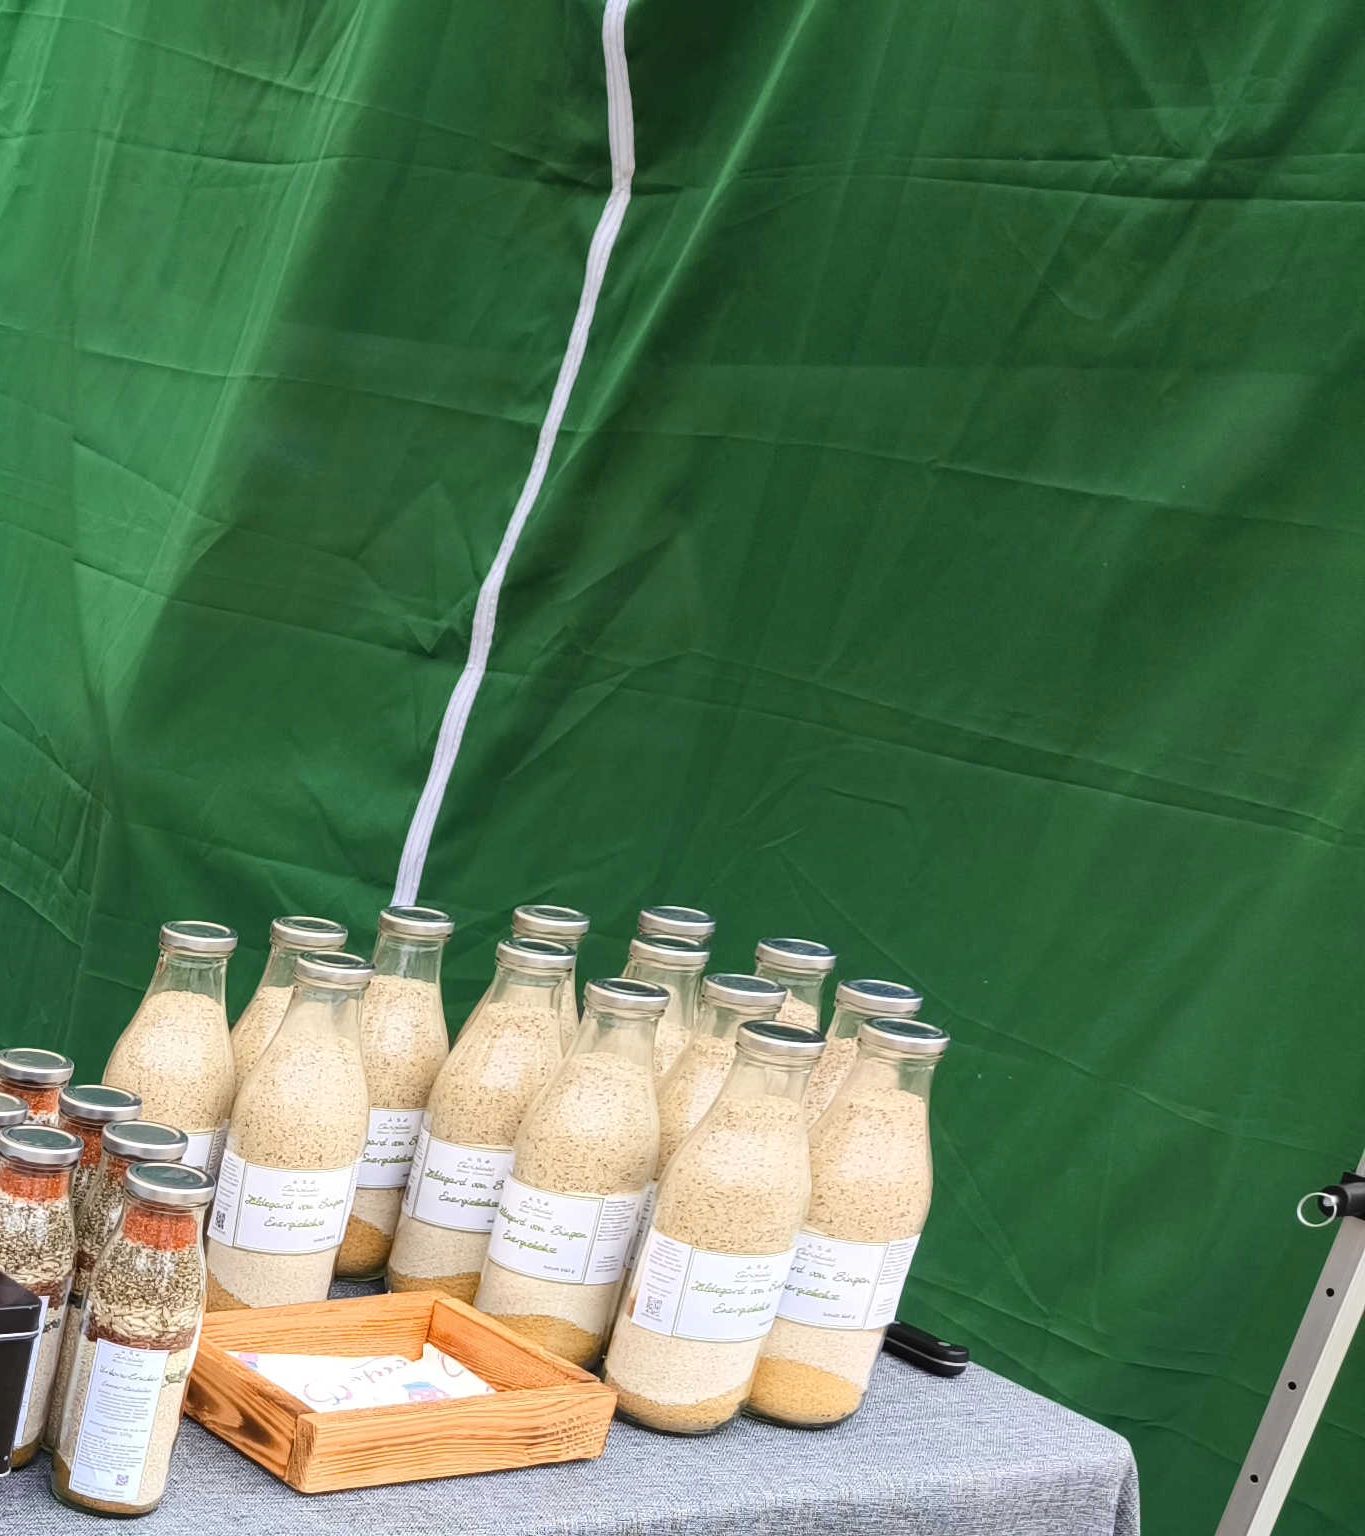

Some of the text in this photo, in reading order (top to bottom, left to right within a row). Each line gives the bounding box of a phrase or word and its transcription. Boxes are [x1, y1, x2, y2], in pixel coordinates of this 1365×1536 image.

[550, 1224, 588, 1241] Bingen
[832, 1271, 871, 1287] Bingen
[690, 1280, 747, 1298] Hildegard
